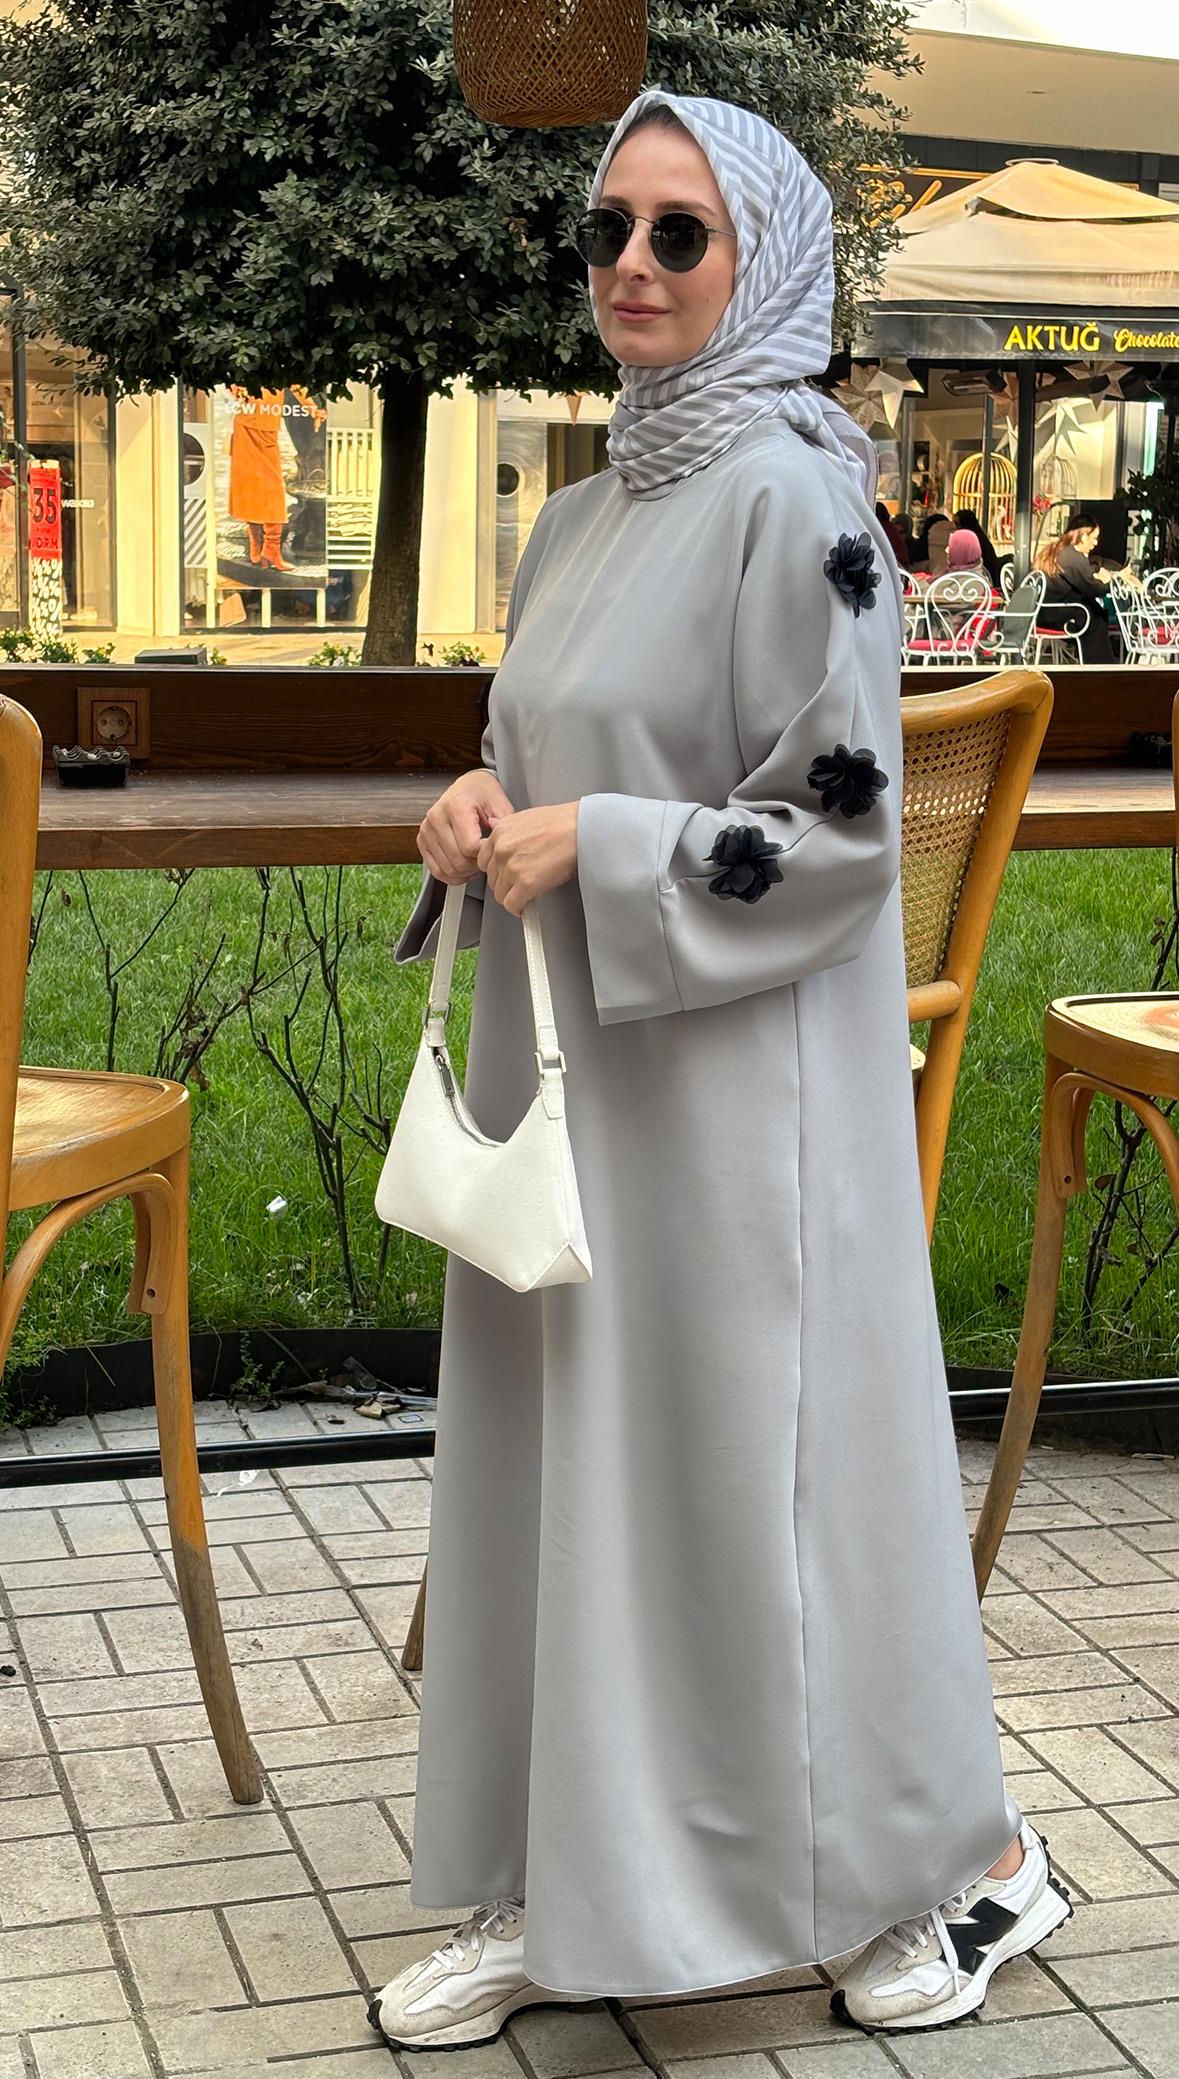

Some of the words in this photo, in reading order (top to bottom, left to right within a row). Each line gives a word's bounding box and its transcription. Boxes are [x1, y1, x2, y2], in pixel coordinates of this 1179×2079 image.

[1004, 322, 1100, 352] AKTUĞ
[260, 404, 318, 417] MODEST
[33, 488, 57, 523] 35
